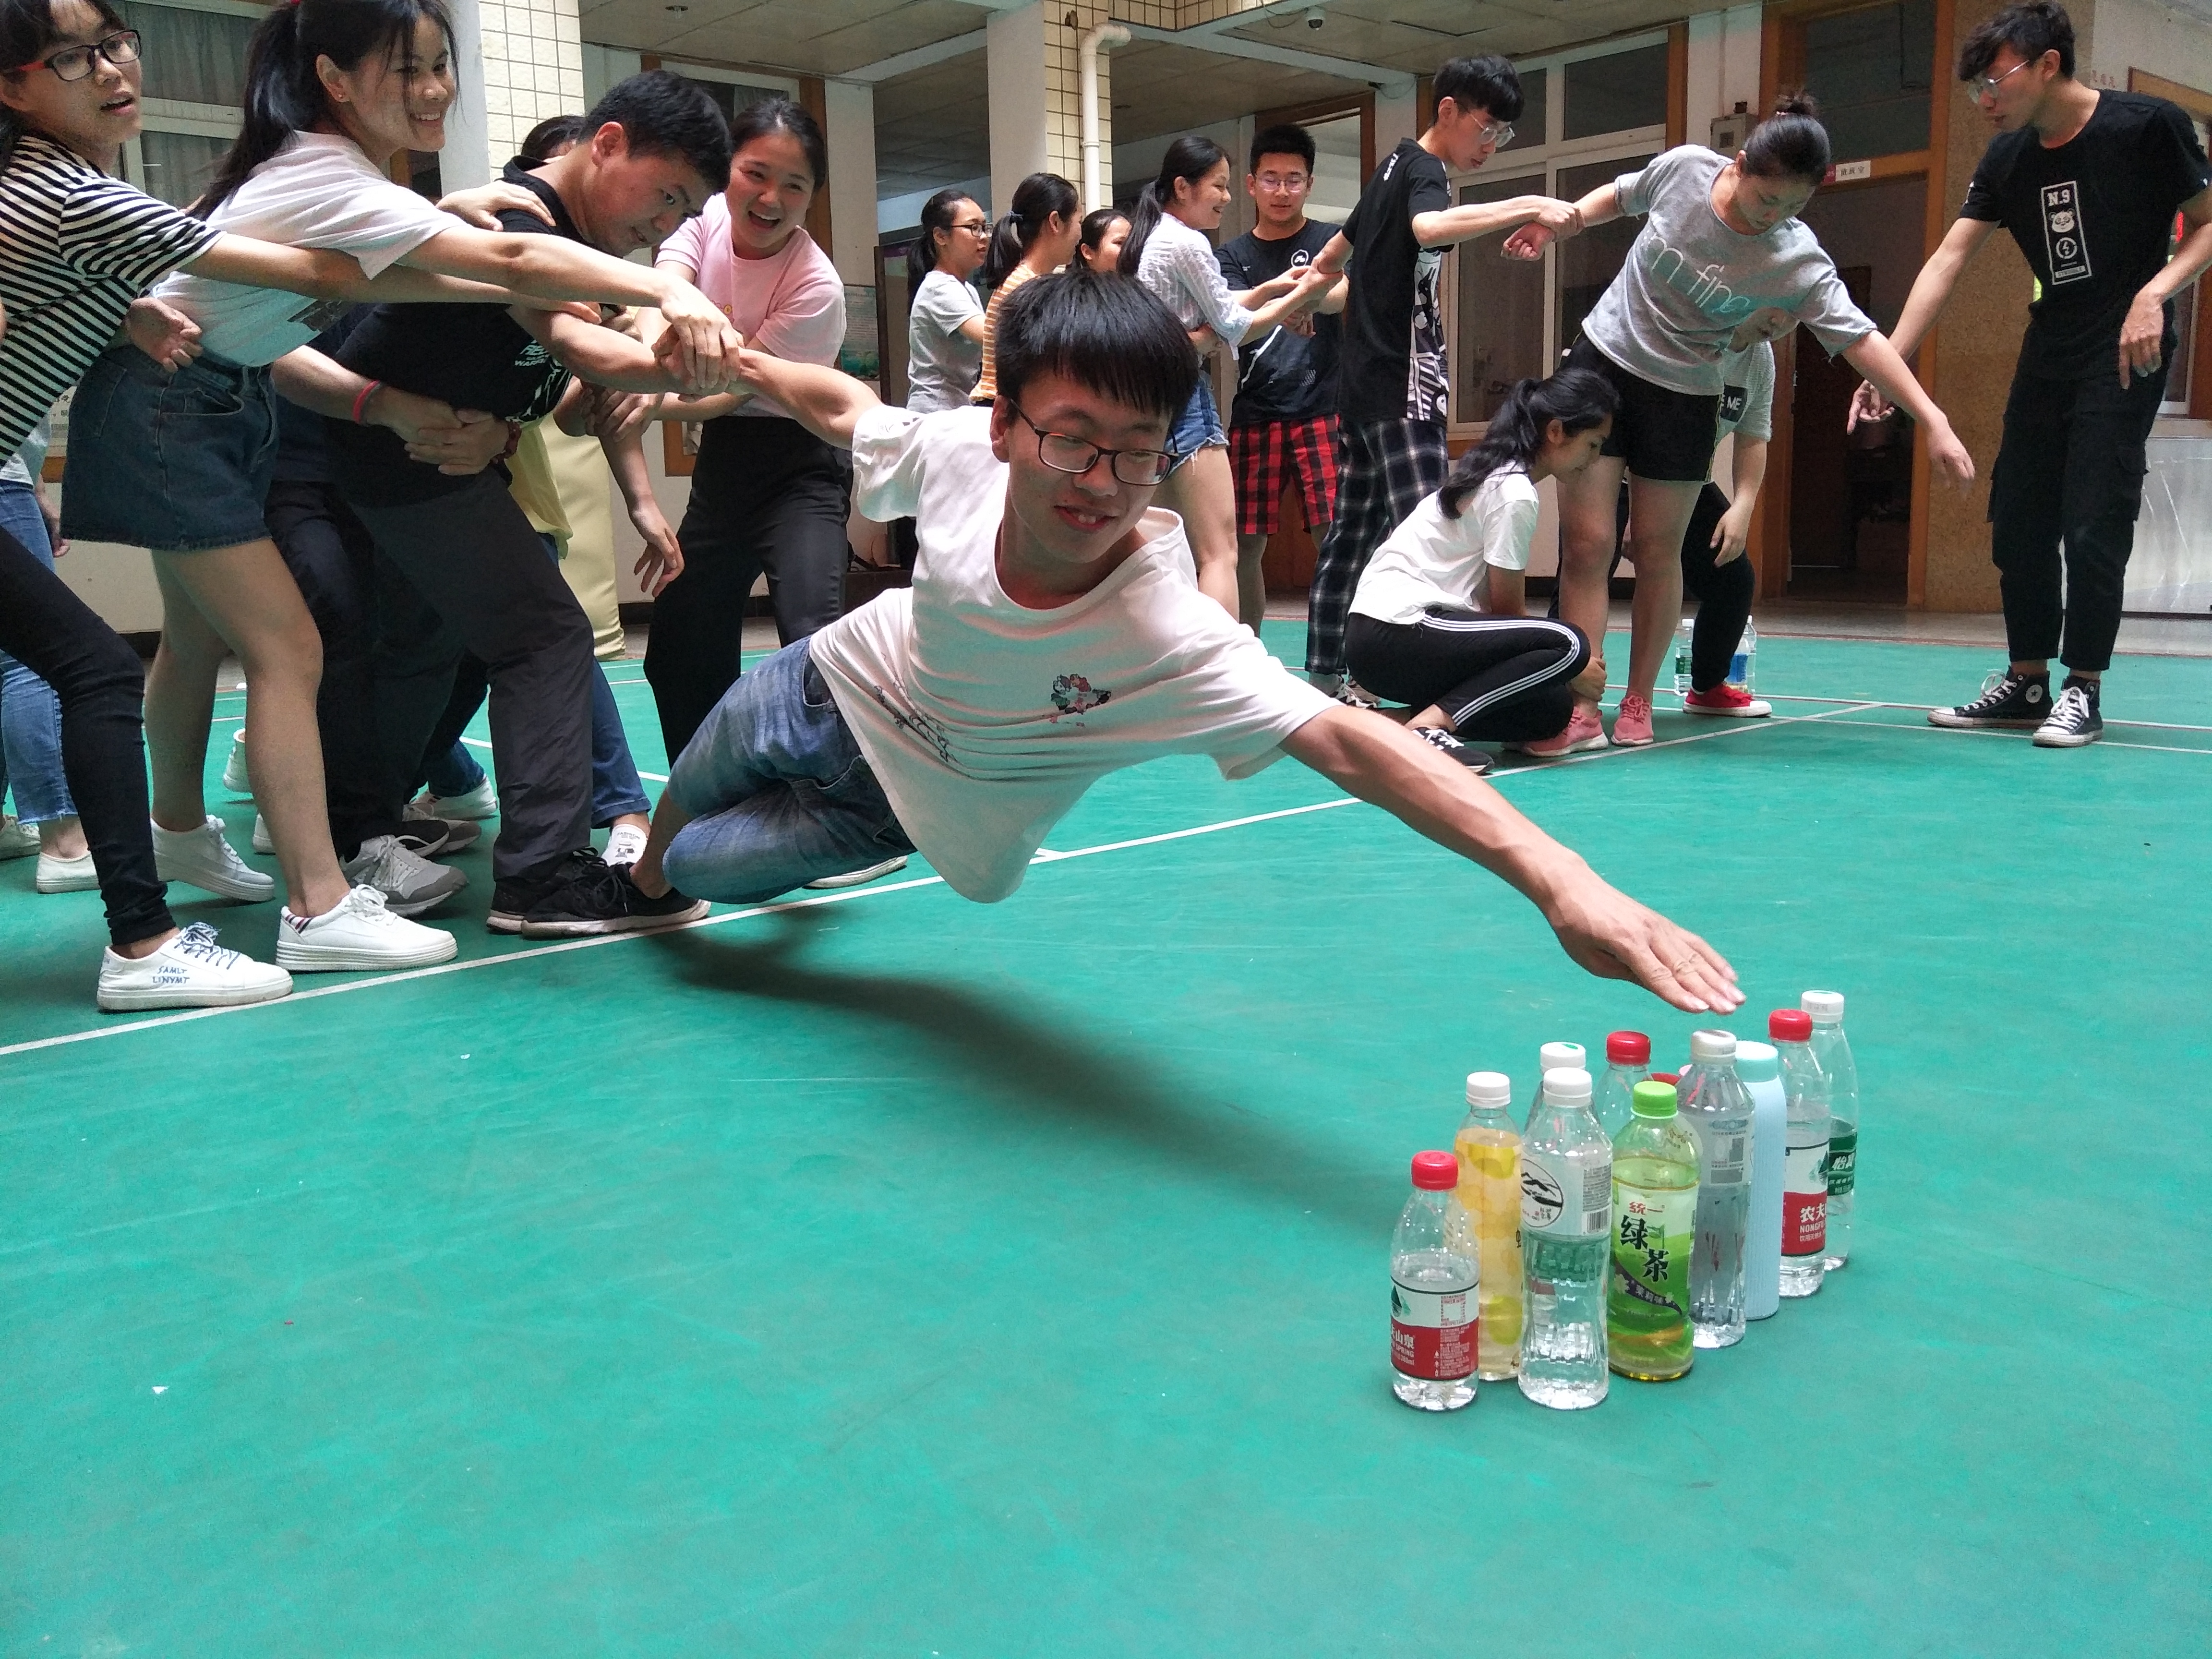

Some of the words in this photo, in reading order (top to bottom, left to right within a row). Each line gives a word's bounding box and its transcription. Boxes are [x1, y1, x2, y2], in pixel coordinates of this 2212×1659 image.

[1727, 396, 1742, 411] ME
[1629, 1202, 1663, 1215] 统一
[1395, 1343, 1414, 1358] SPRING
